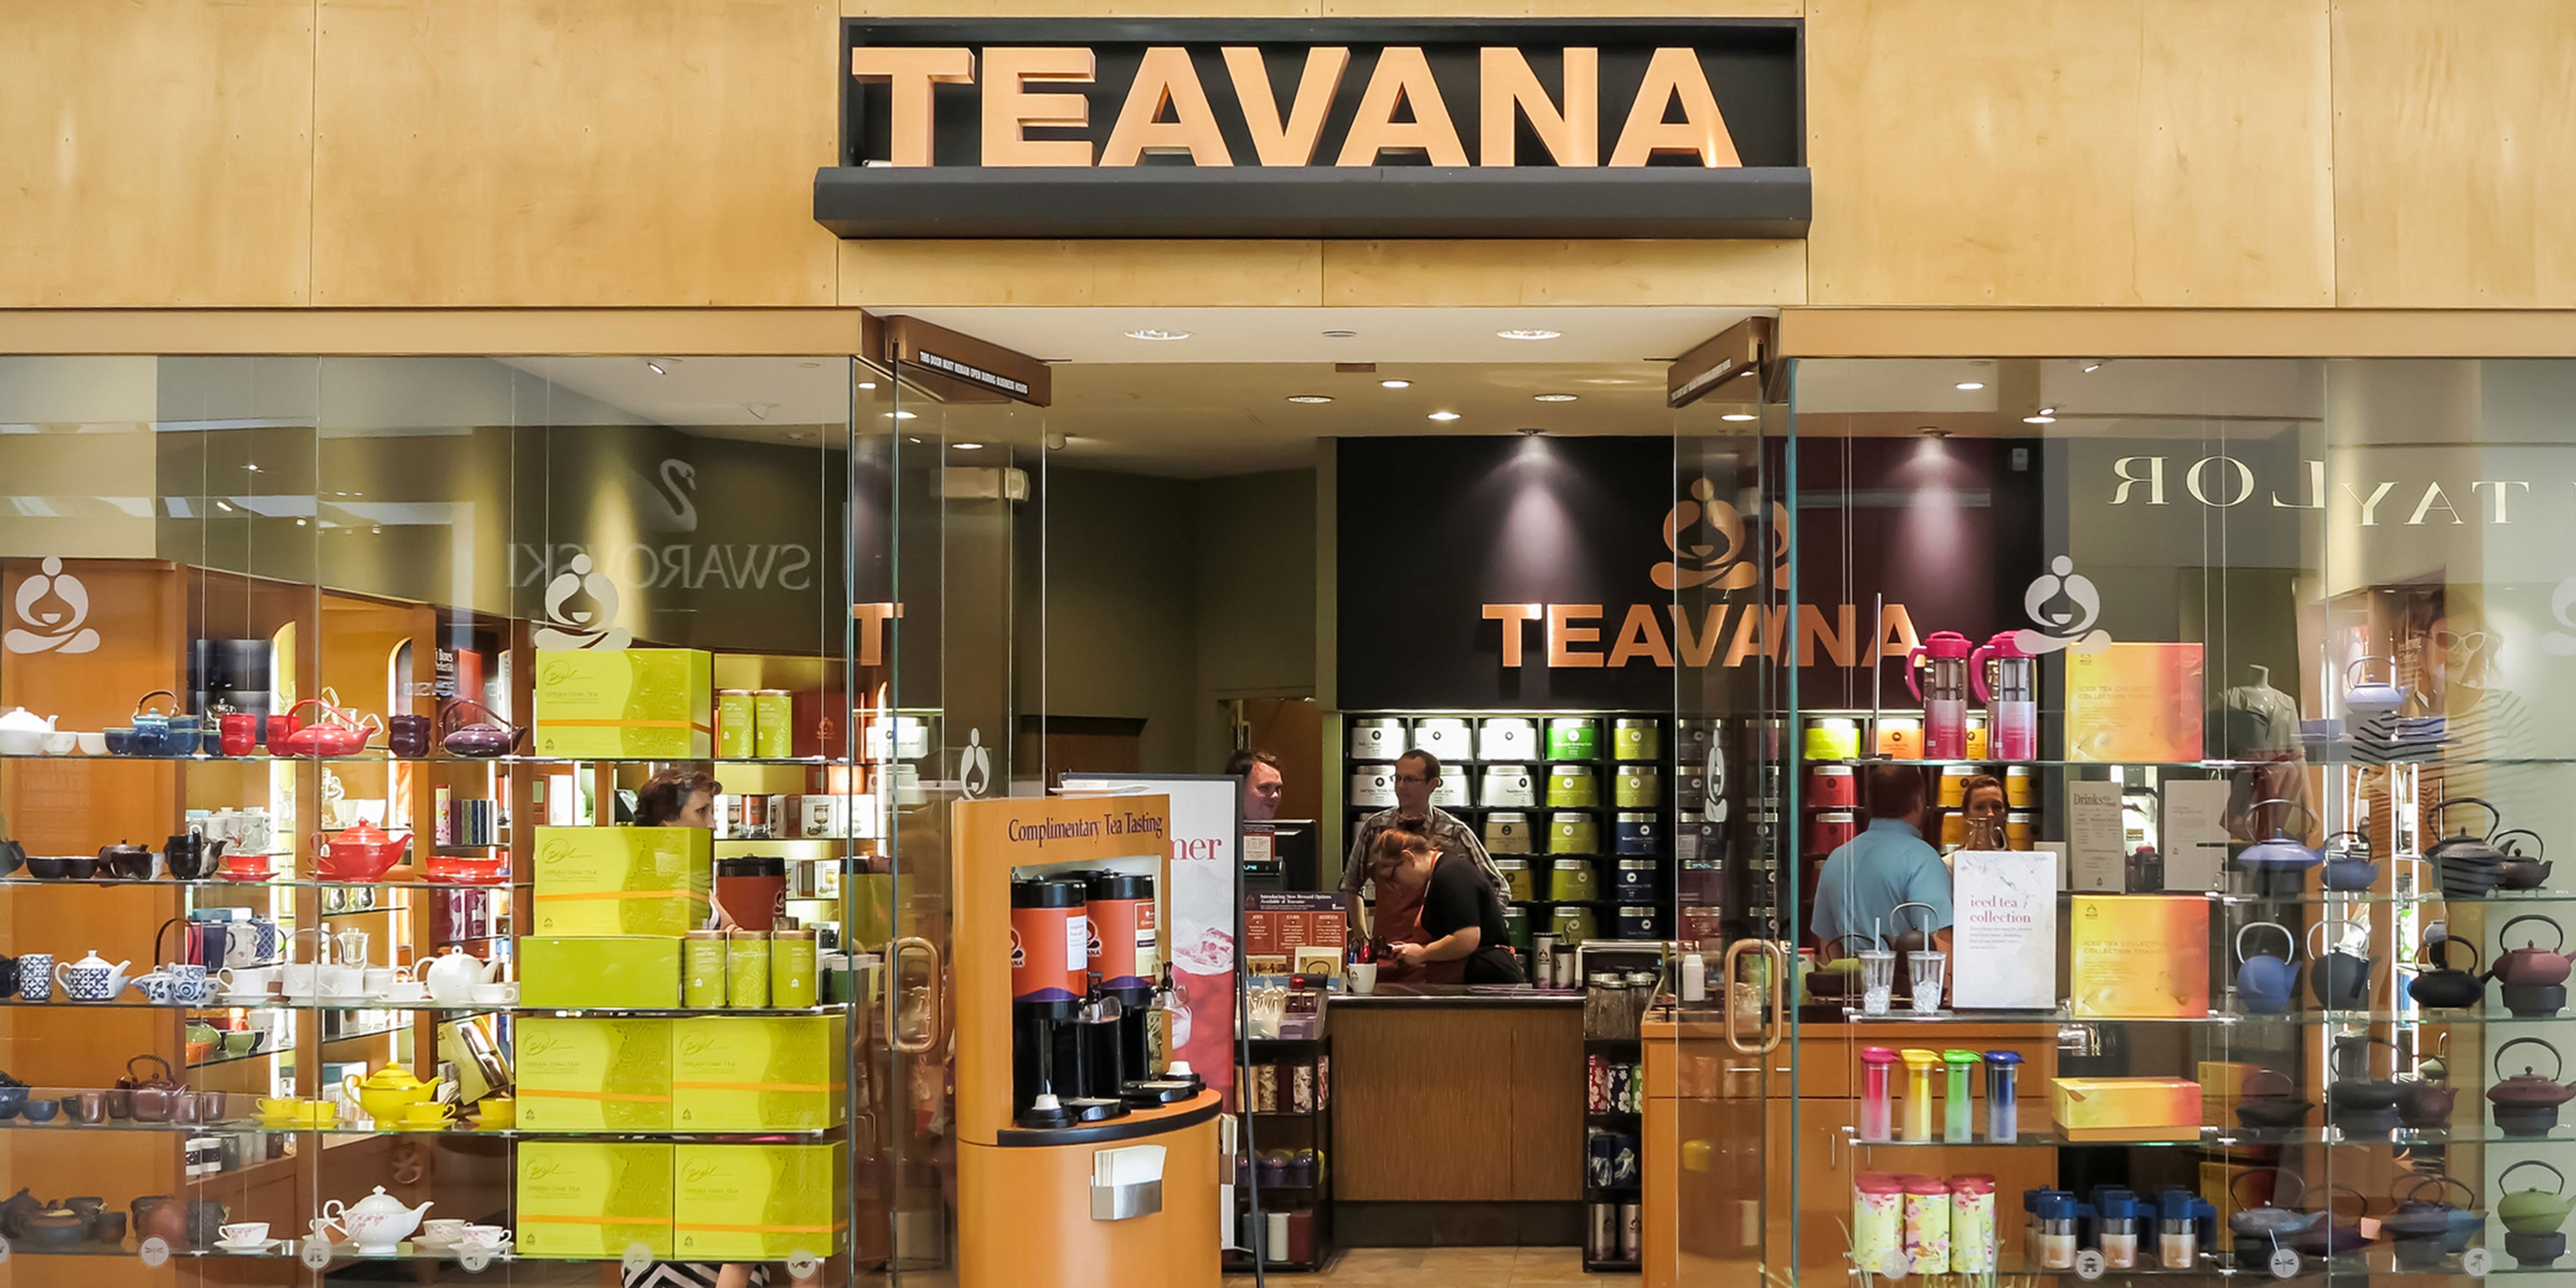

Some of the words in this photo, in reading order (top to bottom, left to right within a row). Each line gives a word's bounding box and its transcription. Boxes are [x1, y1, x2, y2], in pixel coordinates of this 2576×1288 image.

[851, 46, 1743, 168] TEAVANA
[1482, 603, 1926, 668] TEAVANA
[1009, 817, 1101, 848] Complimentary
[1104, 814, 1122, 835] Tea
[1124, 811, 1162, 838] Tasting
[1970, 911, 2031, 923] collection
[1971, 895, 1996, 907] iced
[2000, 898, 2018, 907] tea
